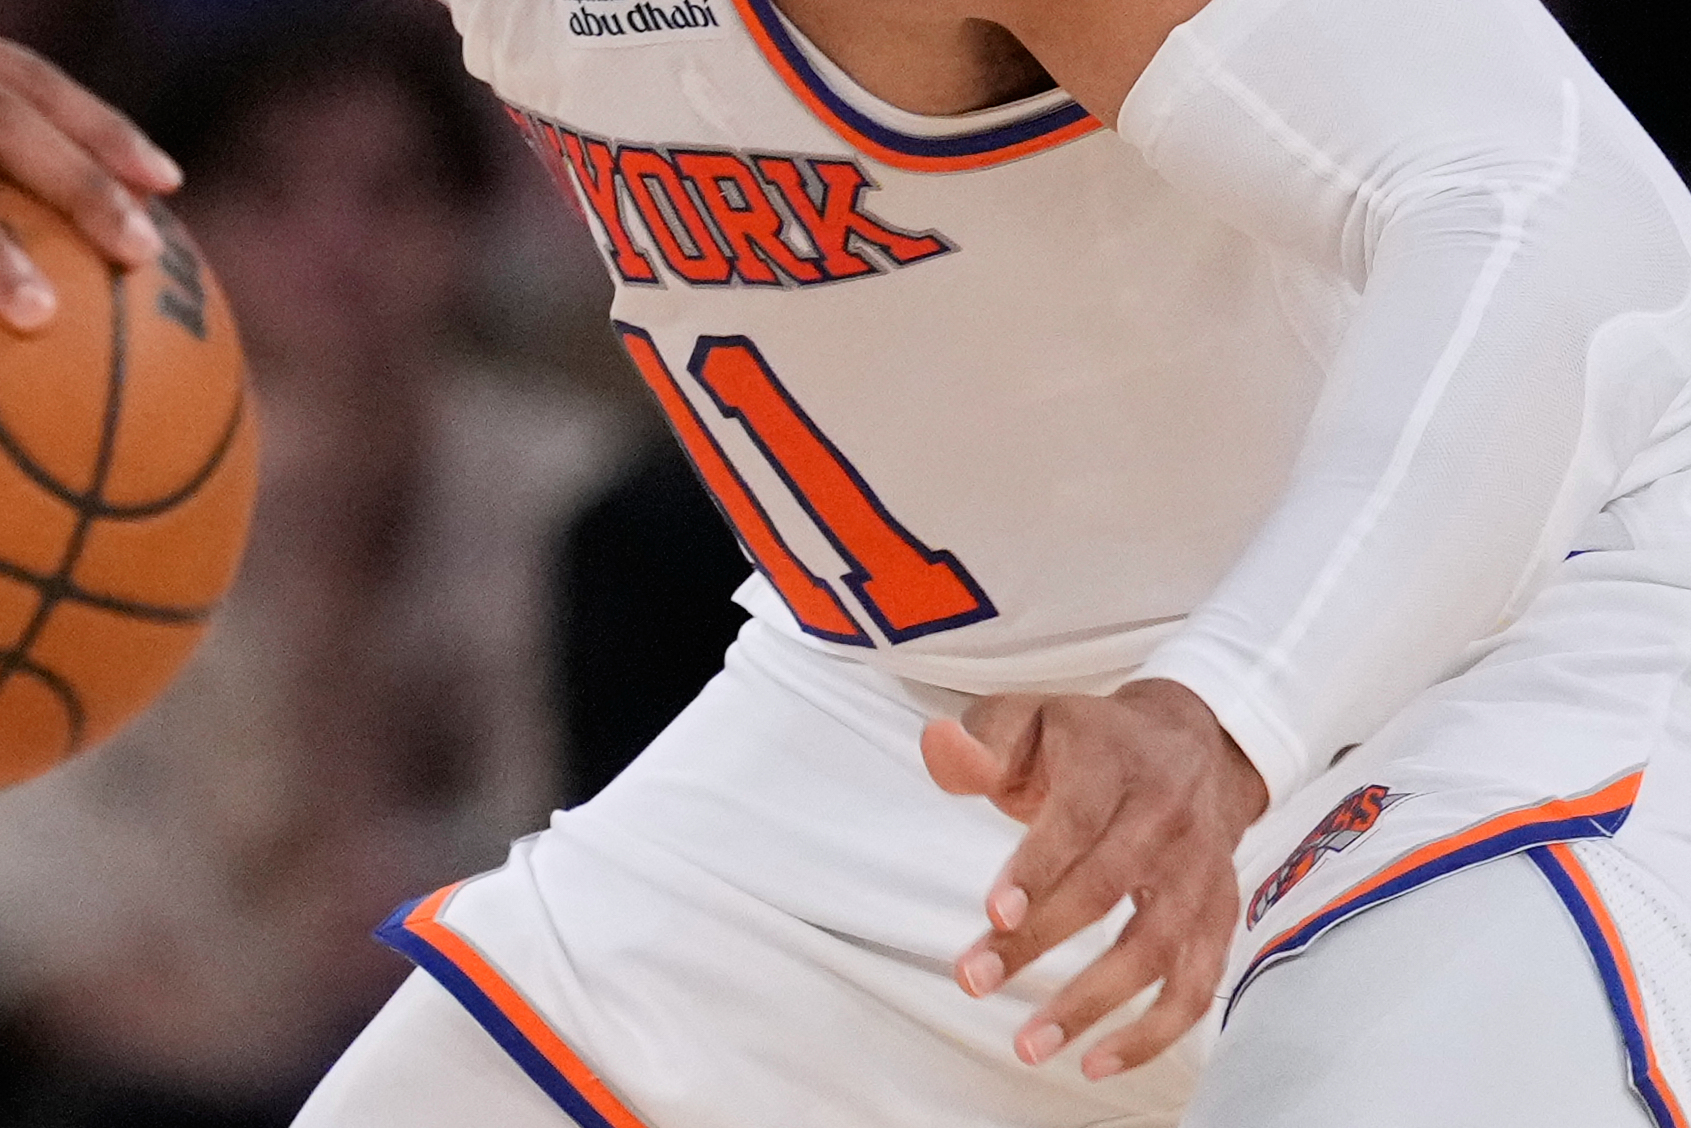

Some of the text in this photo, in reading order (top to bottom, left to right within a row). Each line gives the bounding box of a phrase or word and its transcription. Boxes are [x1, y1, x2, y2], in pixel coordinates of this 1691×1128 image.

[569, 6, 626, 37] abu
[557, 127, 955, 286] YORK
[610, 319, 1000, 649] 11
